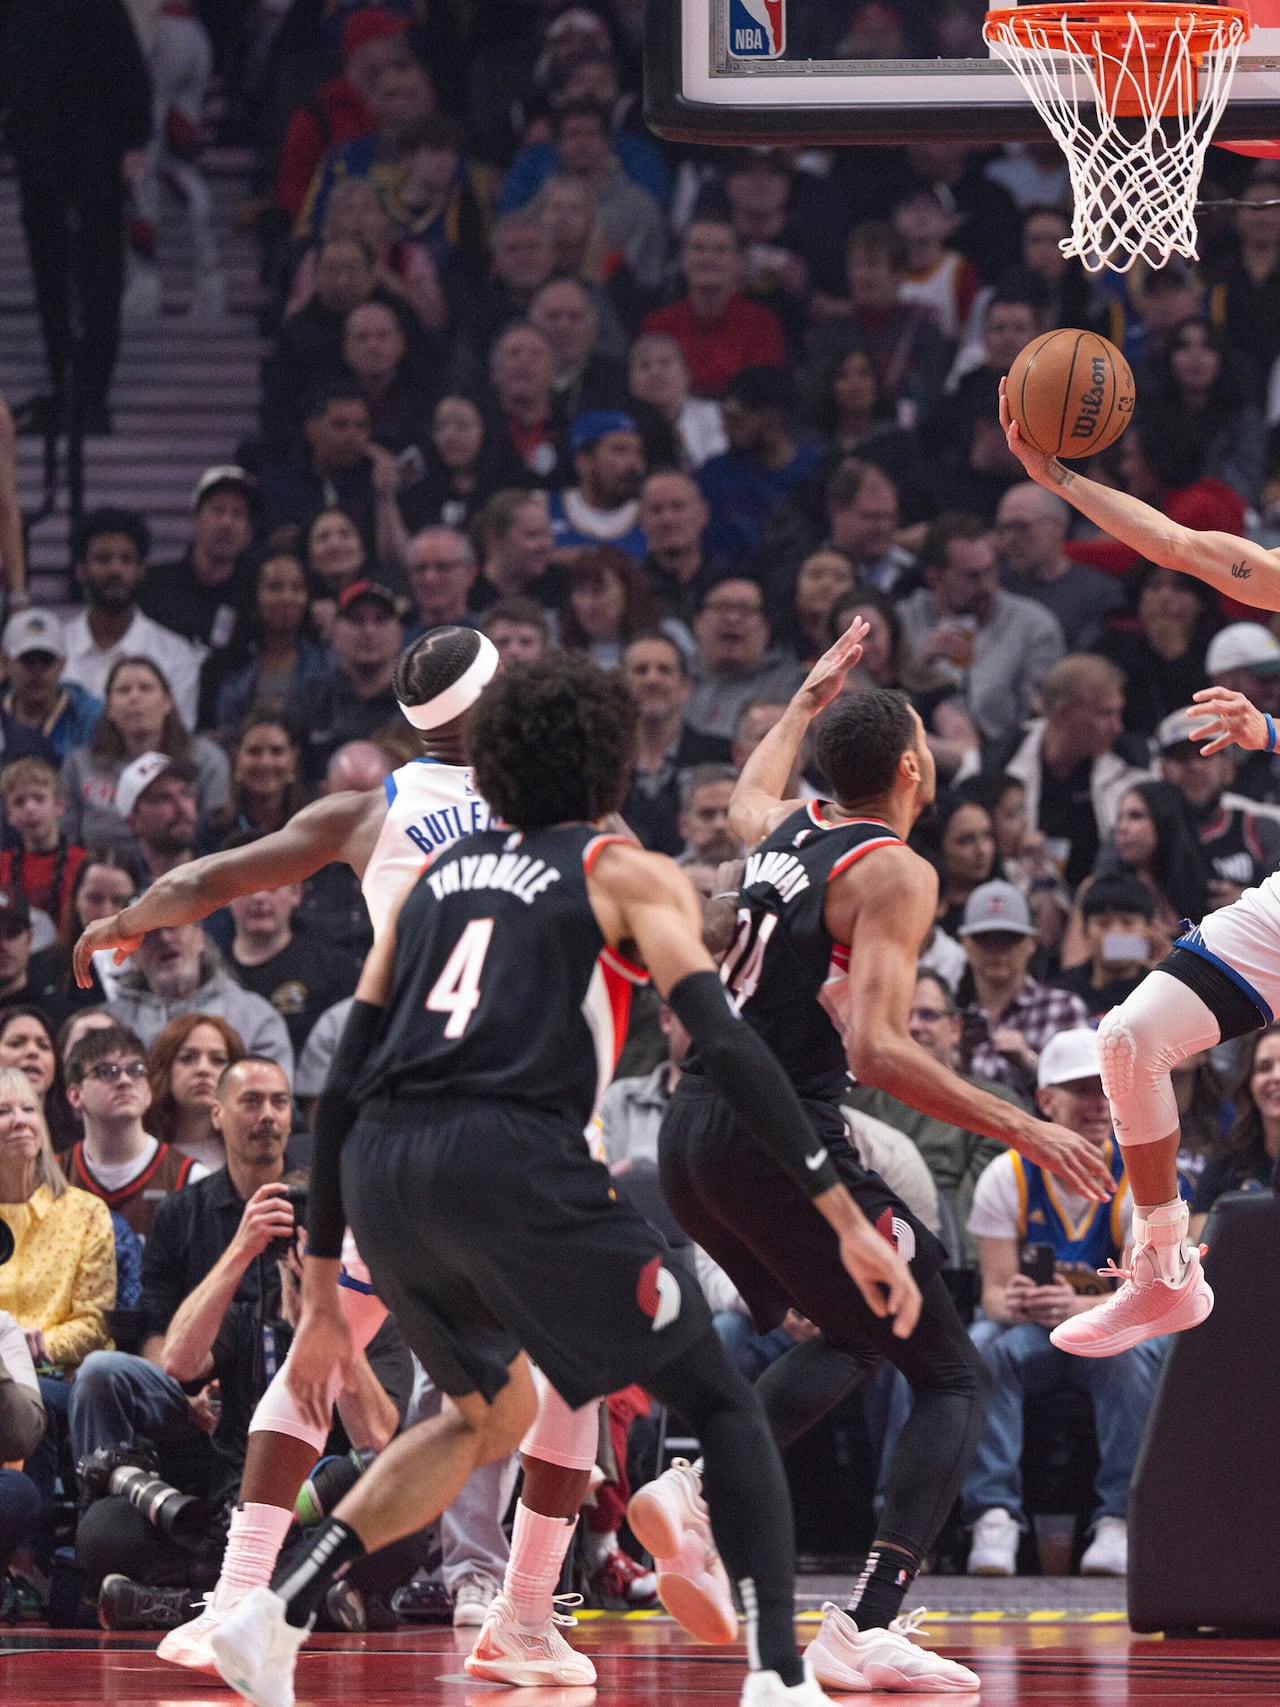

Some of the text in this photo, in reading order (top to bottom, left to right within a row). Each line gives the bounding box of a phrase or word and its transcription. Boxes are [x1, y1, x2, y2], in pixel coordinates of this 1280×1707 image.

[735, 28, 763, 50] NBA
[1071, 357, 1105, 438] Wilson
[425, 917, 495, 1039] 4
[719, 906, 780, 1012] 24
